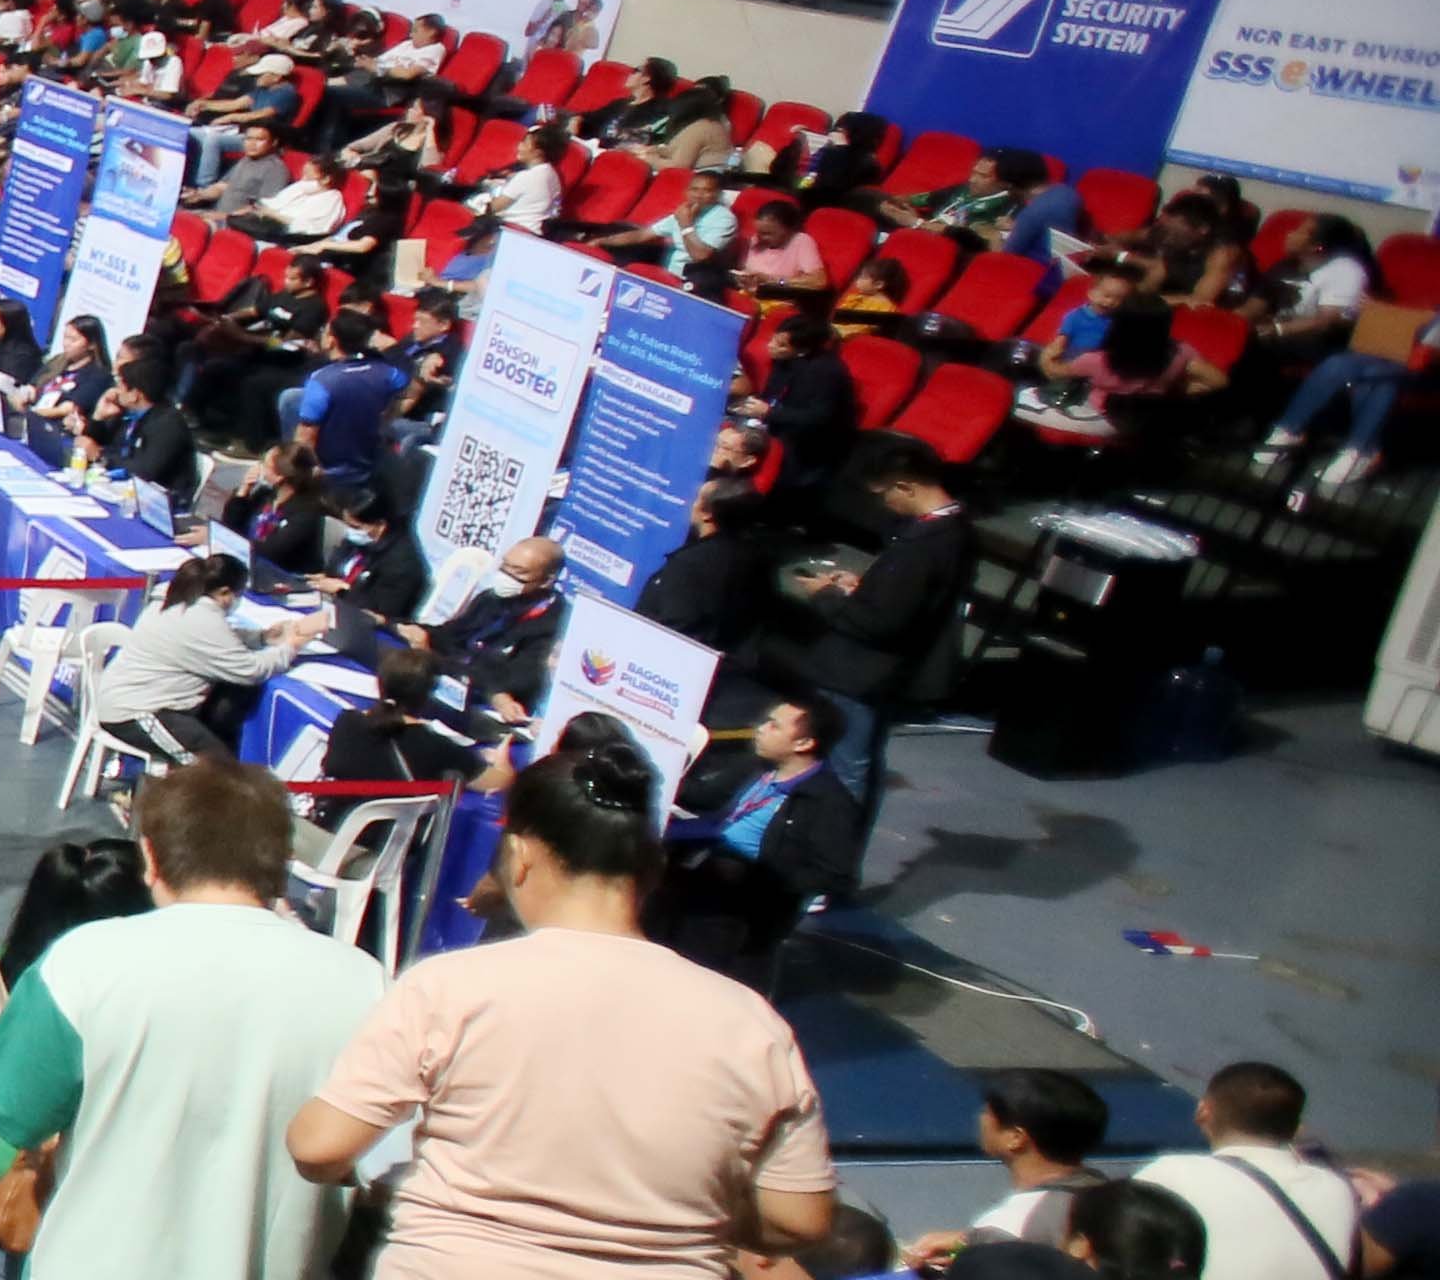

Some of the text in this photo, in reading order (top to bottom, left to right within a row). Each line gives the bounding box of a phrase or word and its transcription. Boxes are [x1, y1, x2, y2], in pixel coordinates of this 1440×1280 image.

[1052, 22, 1150, 54] SYSTEM
[1237, 27, 1282, 46] NCR
[1289, 33, 1346, 54] EAST
[1207, 51, 1275, 81] SSS
[489, 336, 540, 369] PENSION
[482, 352, 557, 399] BOOSTER
[620, 672, 679, 709] PILIPINAS
[626, 661, 679, 694] BAGONG
